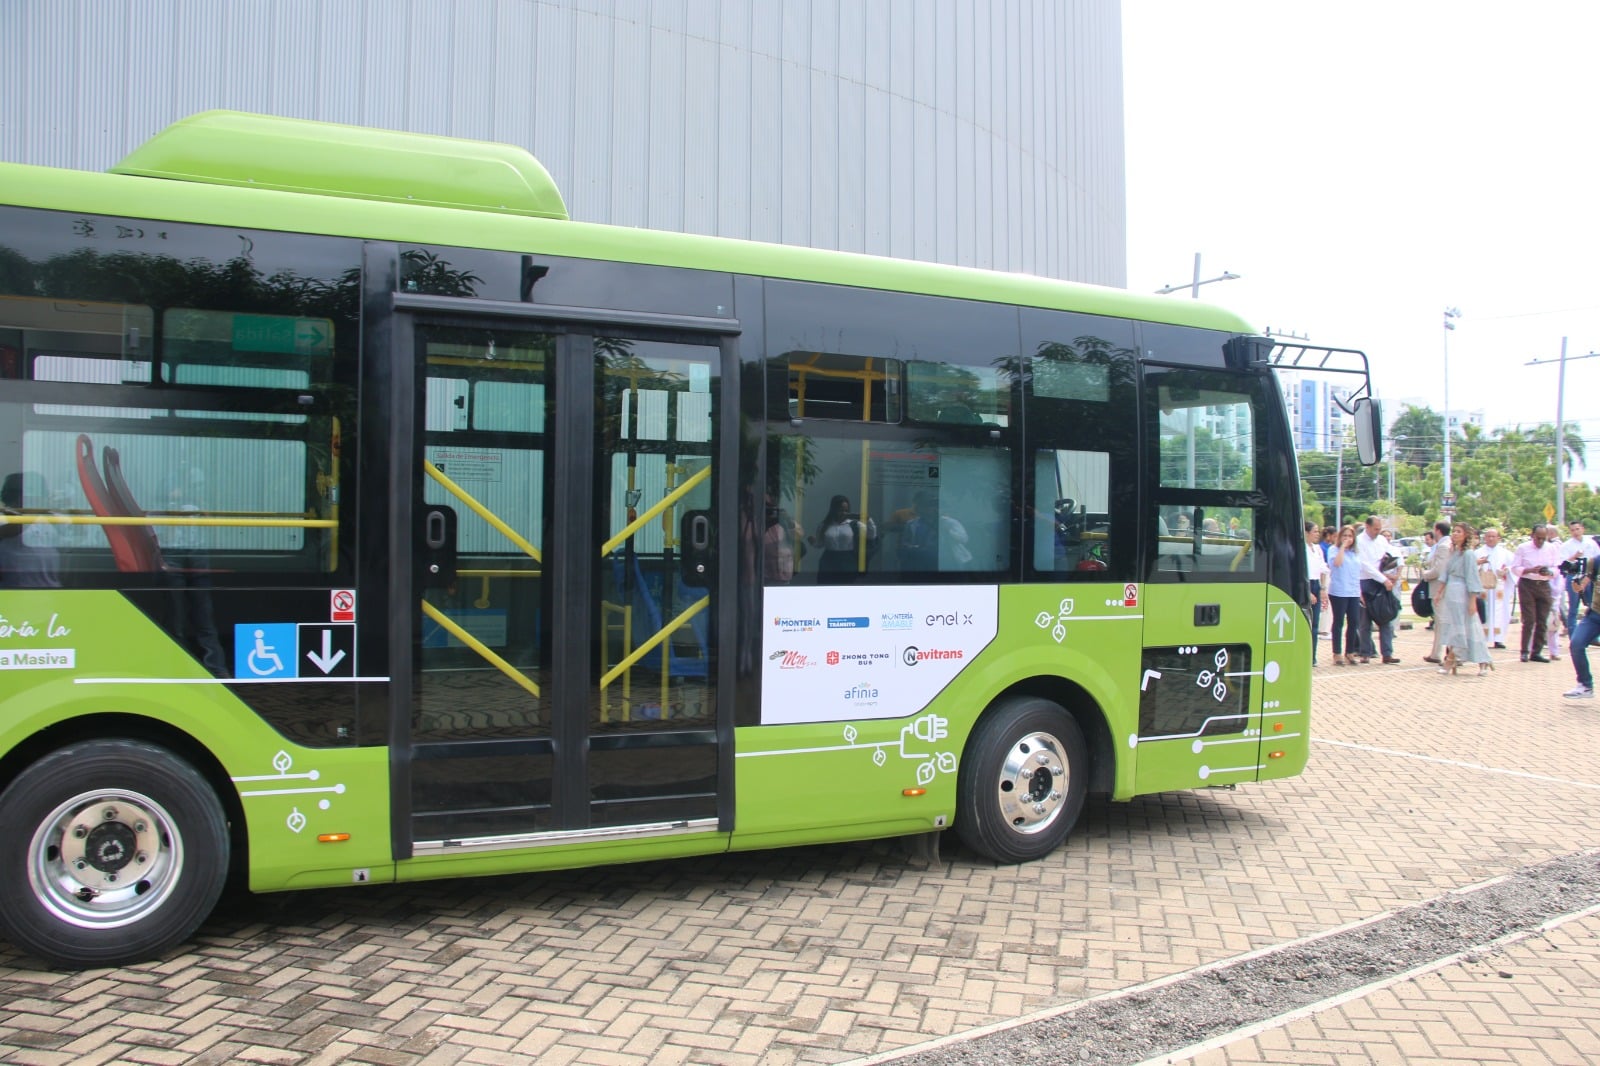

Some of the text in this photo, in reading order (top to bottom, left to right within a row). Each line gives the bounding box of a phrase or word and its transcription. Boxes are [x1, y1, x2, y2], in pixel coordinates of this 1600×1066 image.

[781, 617, 821, 627] MONTERÍA
[925, 611, 959, 626] enel
[13, 653, 68, 666] Masiva
[903, 646, 963, 666] Navitrans
[844, 686, 879, 699] afinia
